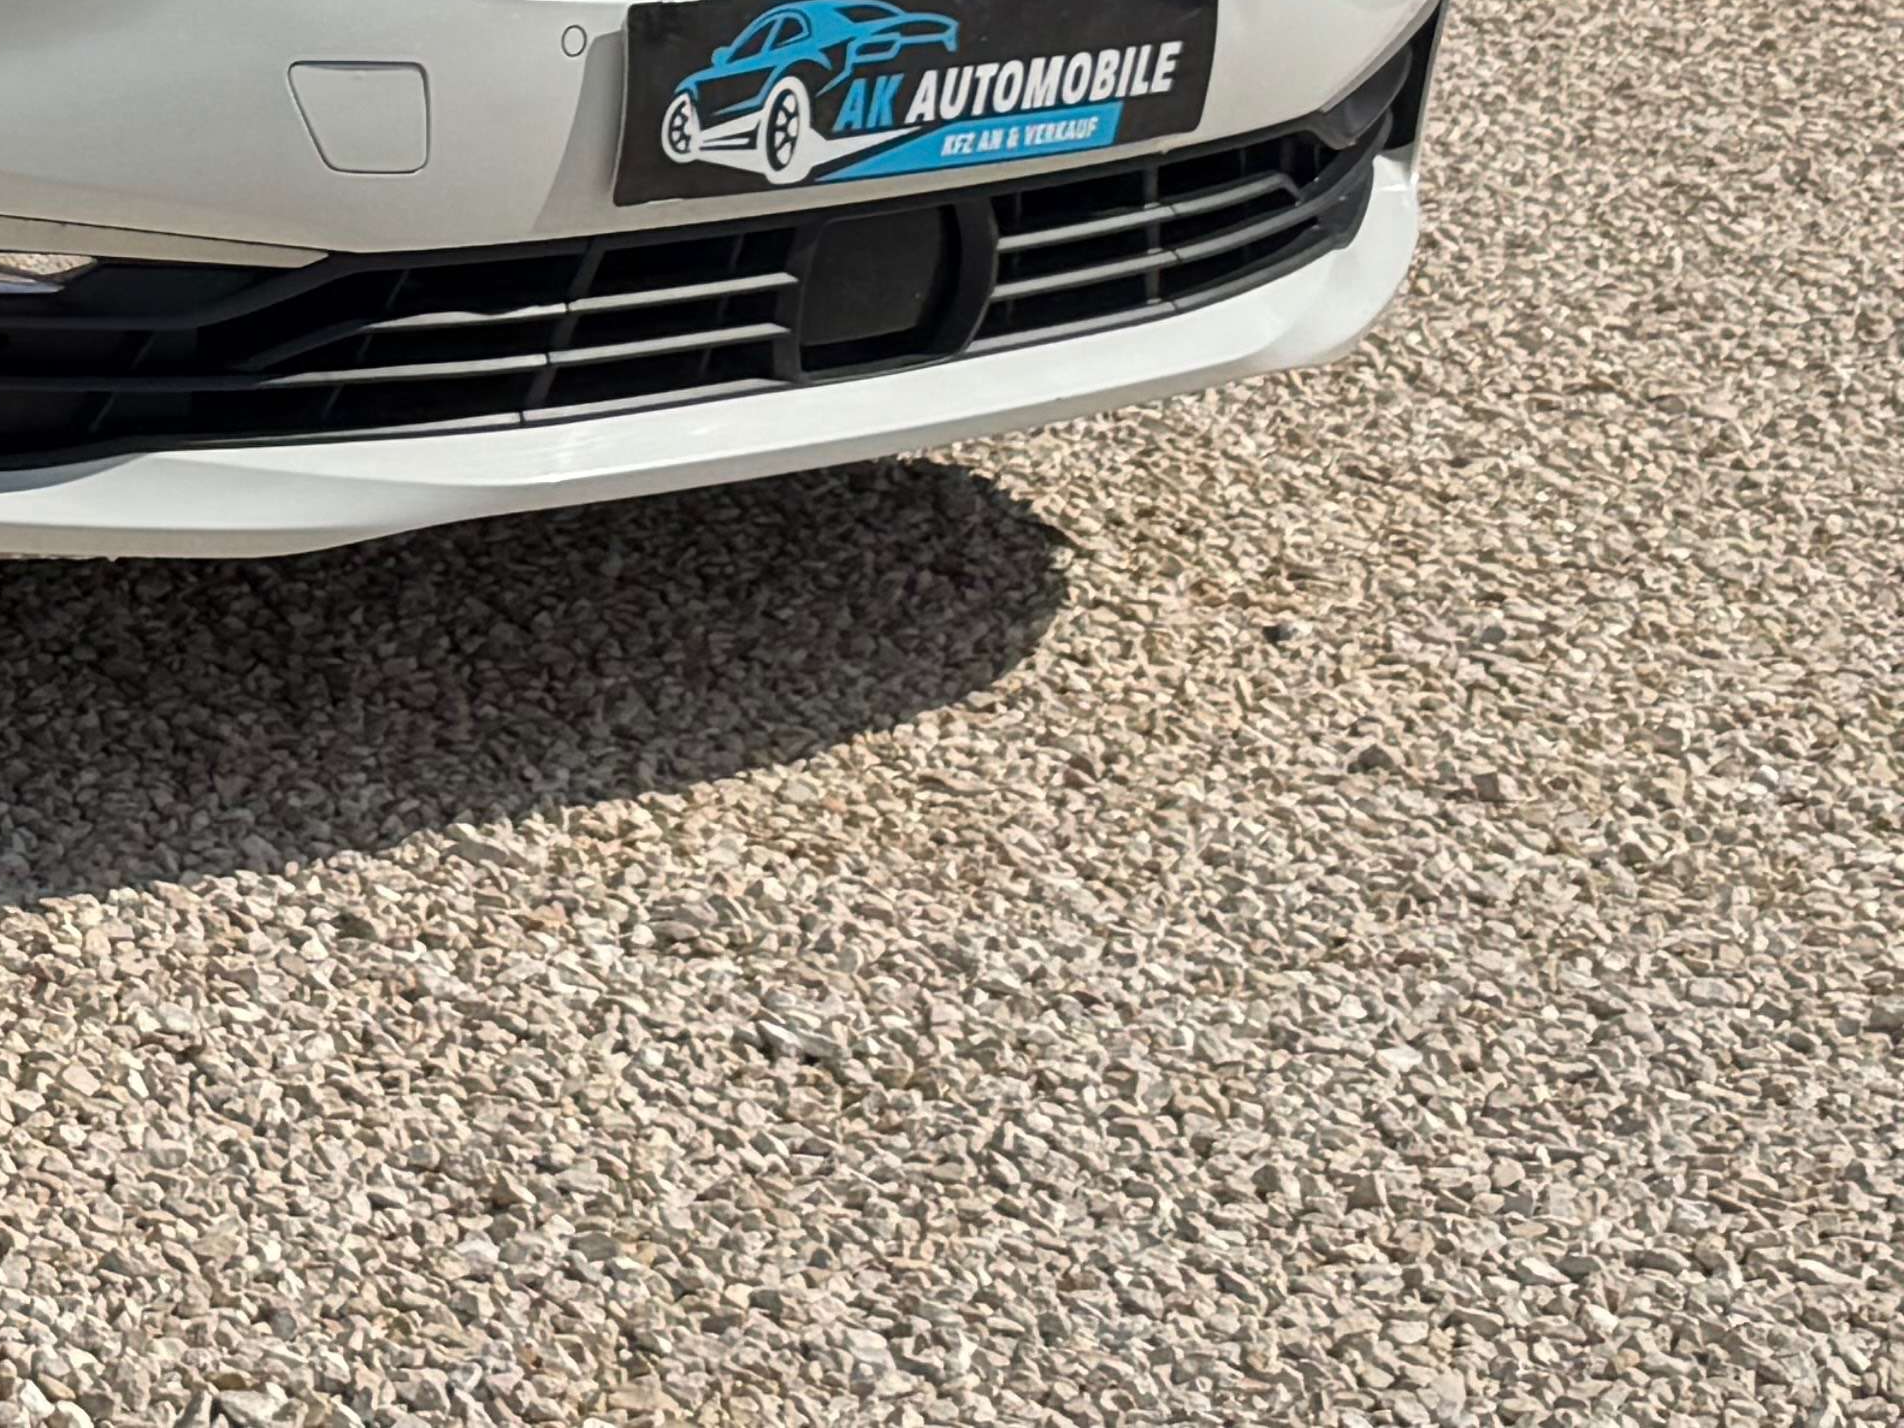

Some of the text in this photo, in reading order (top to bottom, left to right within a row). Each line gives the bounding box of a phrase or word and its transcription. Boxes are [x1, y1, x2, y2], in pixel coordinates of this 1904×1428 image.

[832, 40, 1184, 133] AK AUTOMOBILE
[941, 116, 1099, 157] KFZ AN & VERKAUF
